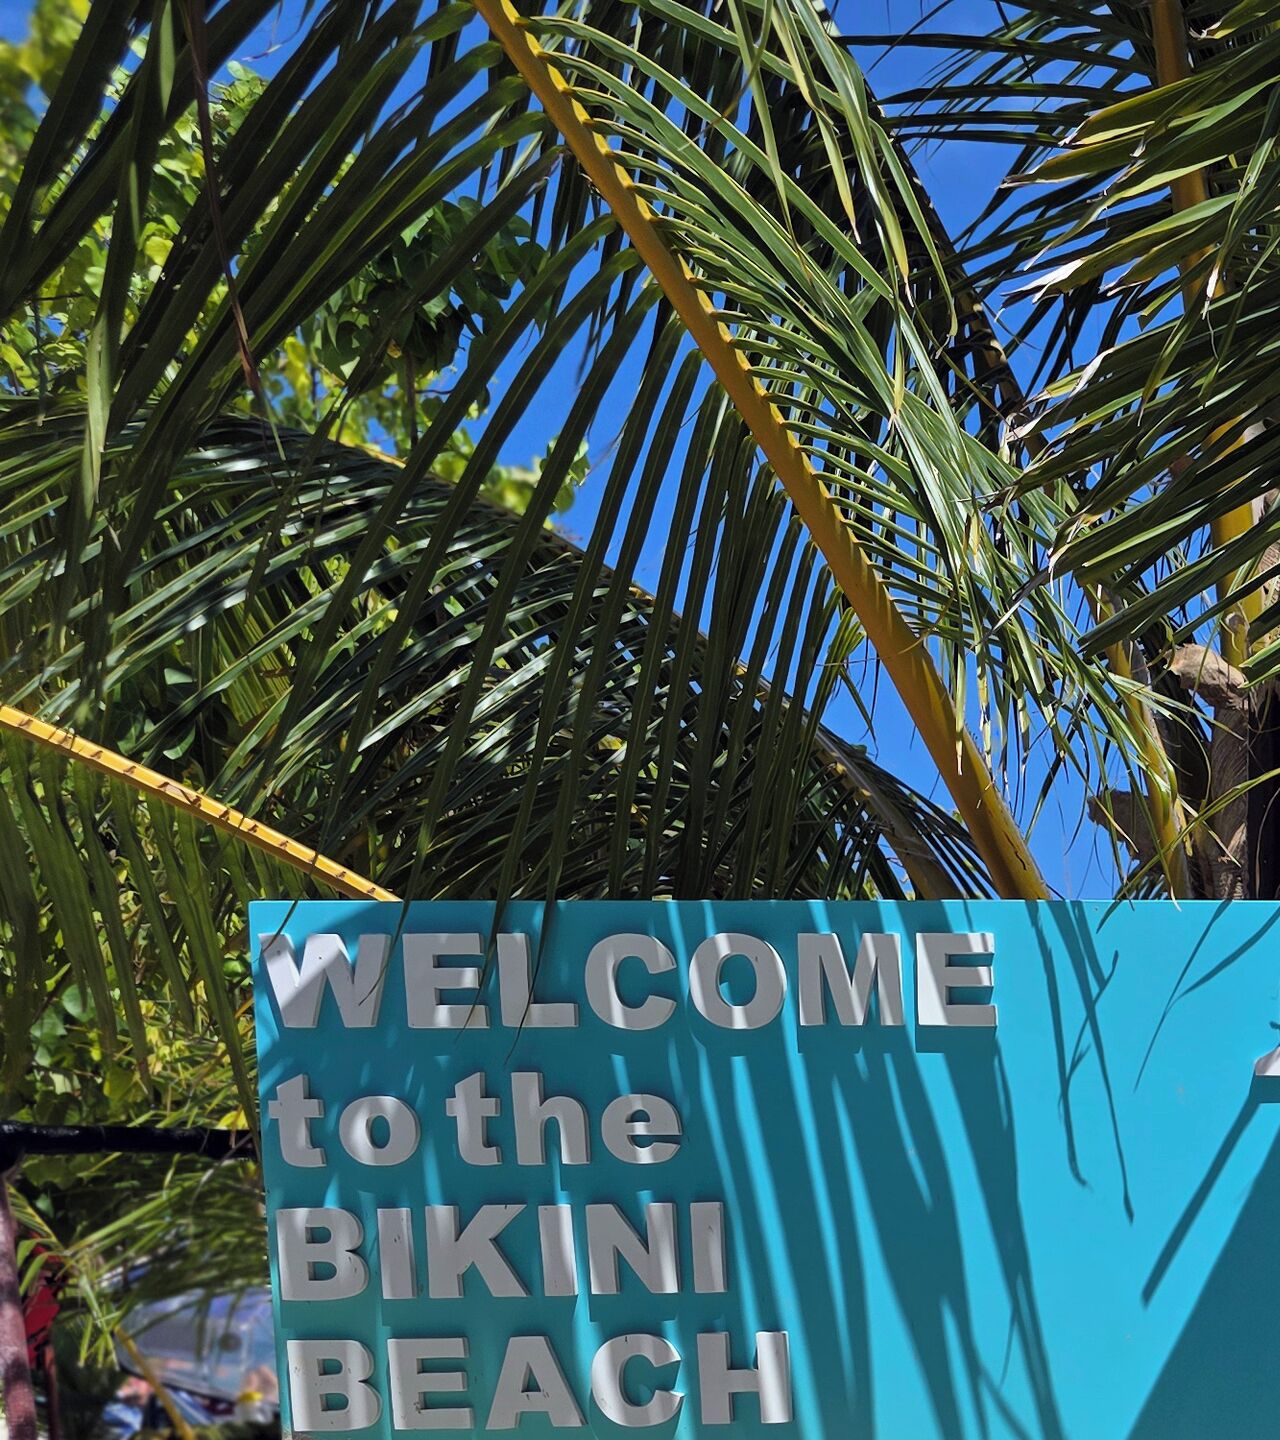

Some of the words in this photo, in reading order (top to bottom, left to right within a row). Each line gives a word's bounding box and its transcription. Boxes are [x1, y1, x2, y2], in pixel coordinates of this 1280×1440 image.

[259, 932, 998, 1030] WELCOME
[269, 1072, 420, 1168] to
[446, 1072, 684, 1166] the
[278, 1203, 728, 1301] BIKINI
[287, 1332, 793, 1431] BEACH
